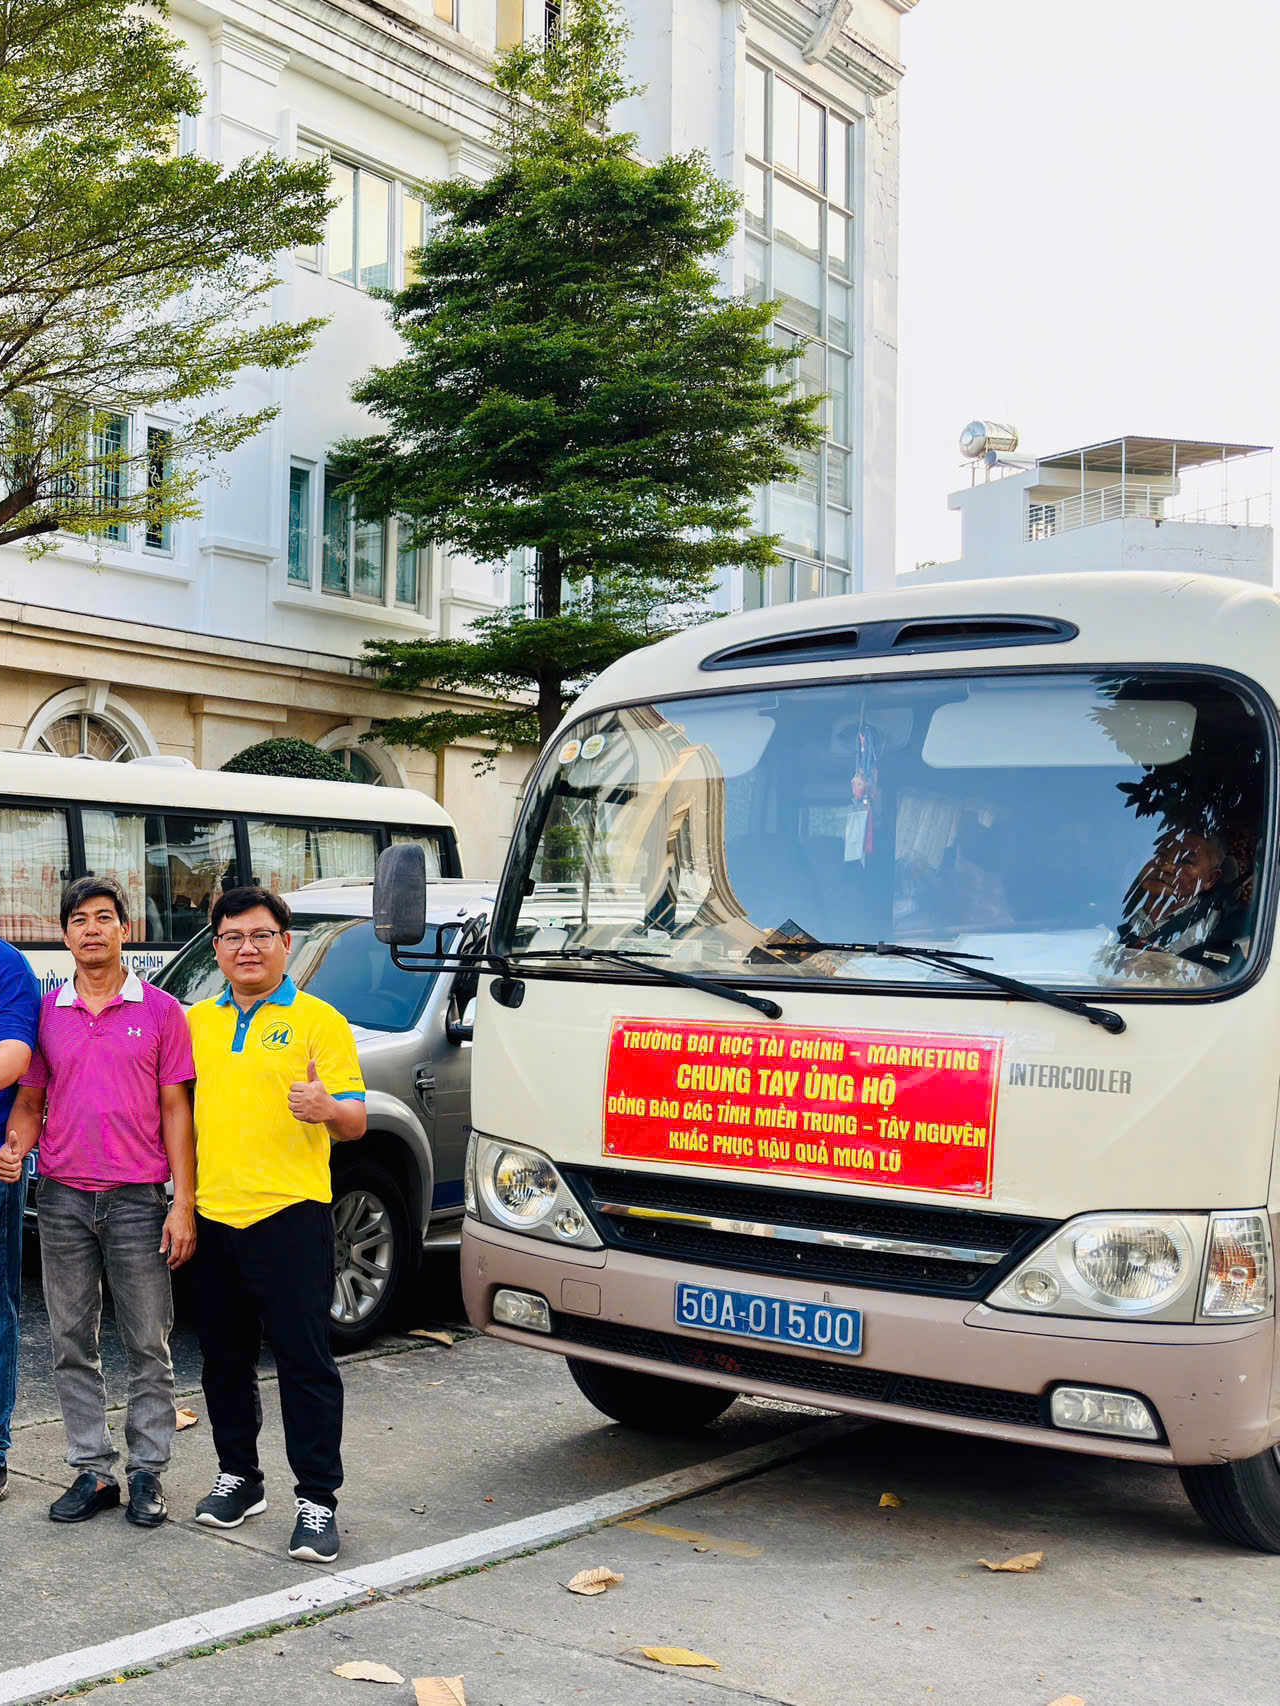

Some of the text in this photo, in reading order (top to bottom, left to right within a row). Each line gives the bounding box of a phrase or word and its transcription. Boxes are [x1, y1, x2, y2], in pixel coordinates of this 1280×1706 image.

[132, 952, 163, 969] CHÍNH
[623, 1029, 682, 1051] TRƯỜNG
[688, 1034, 715, 1056] ĐẠI
[719, 1035, 753, 1059] HỌC
[759, 1035, 785, 1058] TÀI
[790, 1038, 845, 1061] CHÍNH
[867, 1045, 980, 1072] MARKETING
[677, 1063, 897, 1112] CHUNG TAY ỦNG HỘ
[1009, 1063, 1132, 1094] INTERCOOLER
[607, 1091, 646, 1116] ĐỒNG
[649, 1097, 680, 1119] BÀO
[683, 1100, 713, 1122] CÁC
[717, 1100, 750, 1125] TỈNH
[754, 1103, 798, 1130] MIỀN
[802, 1111, 858, 1135] TRUNG
[878, 1116, 910, 1140] TÂY
[914, 1122, 986, 1148] NGUYÊN
[669, 1127, 902, 1173] KHẮC PHỤC HẬU QUẢ MƯA LŨ
[682, 1288, 853, 1347] 50A-015.00
